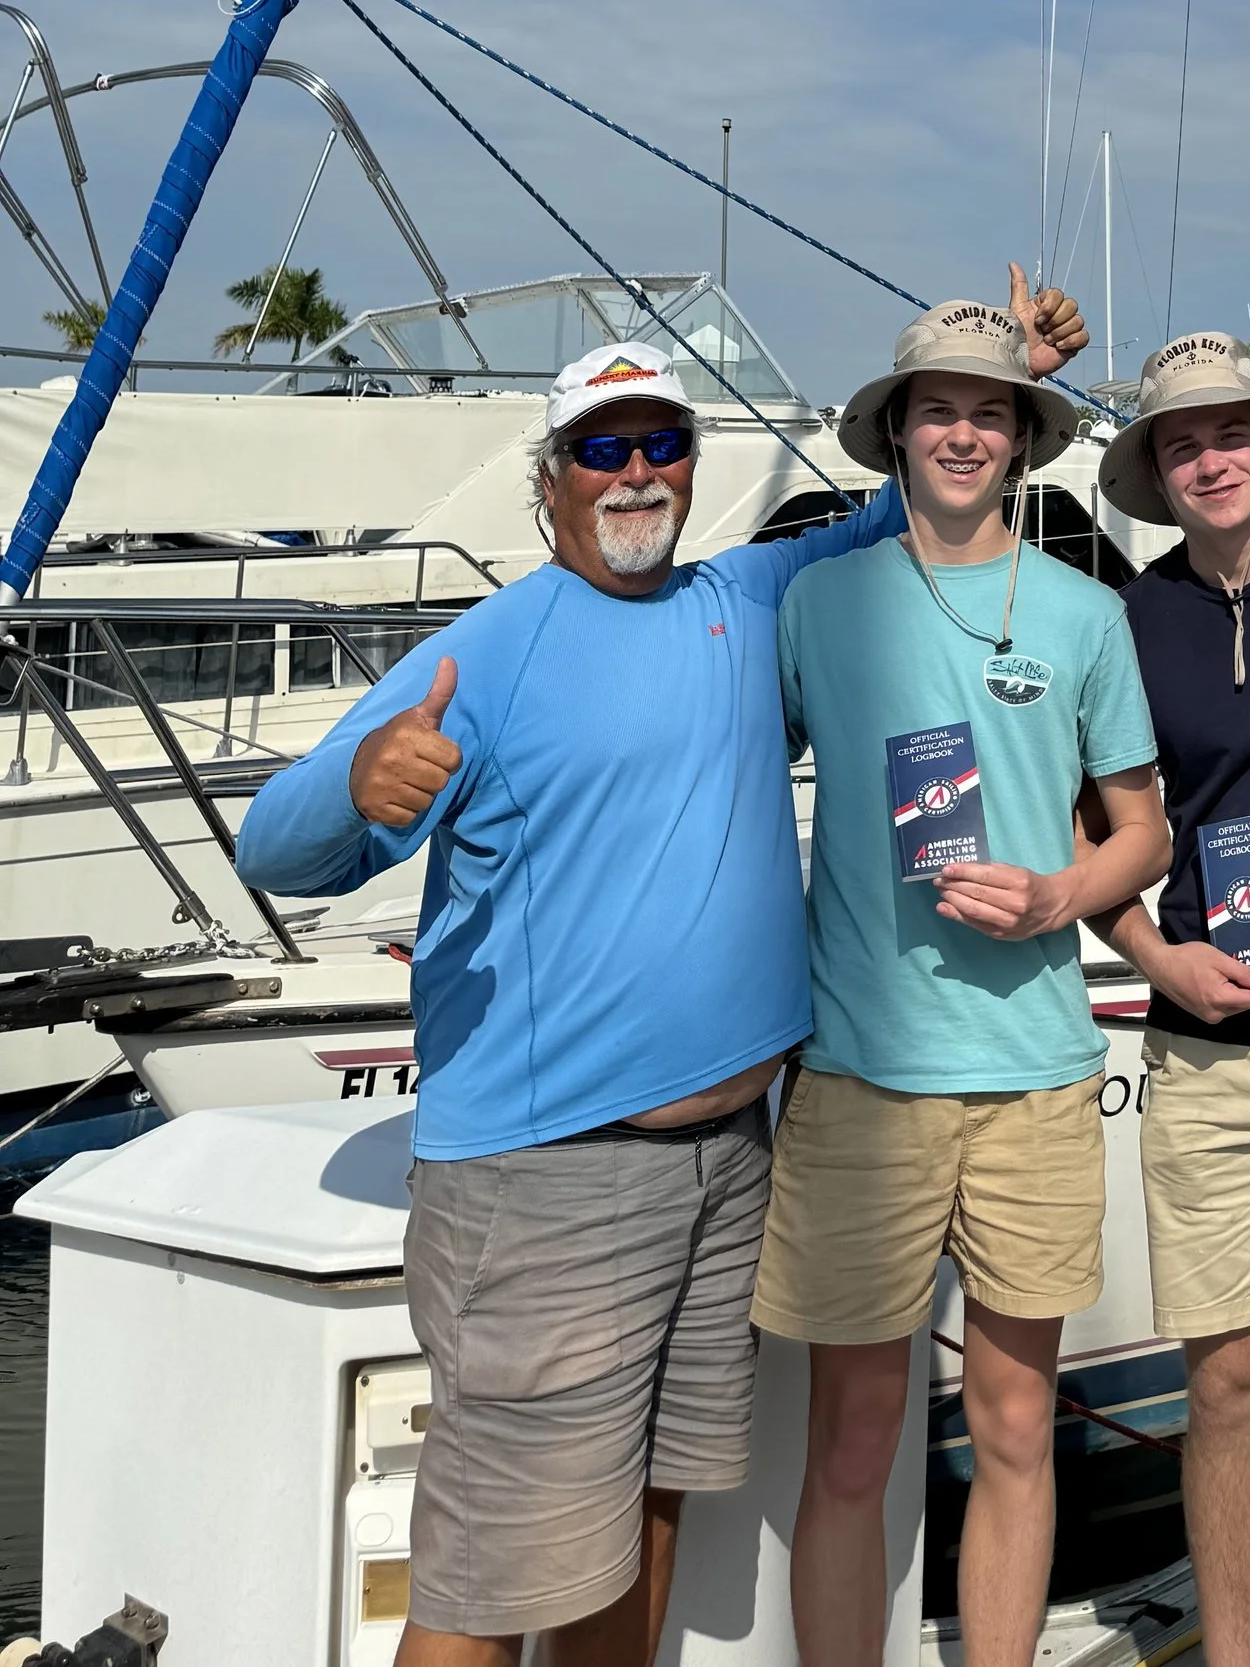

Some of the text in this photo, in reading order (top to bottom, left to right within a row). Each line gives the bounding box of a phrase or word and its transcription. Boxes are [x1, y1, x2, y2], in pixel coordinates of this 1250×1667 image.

[941, 306, 1014, 334] FLORIDA KEYS
[1157, 337, 1228, 368] FLORIDA KEYS
[1172, 359, 1213, 372] FLORIDA
[910, 730, 950, 744] OFFICIAL
[897, 736, 965, 756] CERTIFICATION
[911, 748, 954, 763] LOGBOOK
[927, 836, 976, 851] AMERICAN
[928, 844, 977, 858] SAILING
[914, 853, 978, 869] ASSOCIATION
